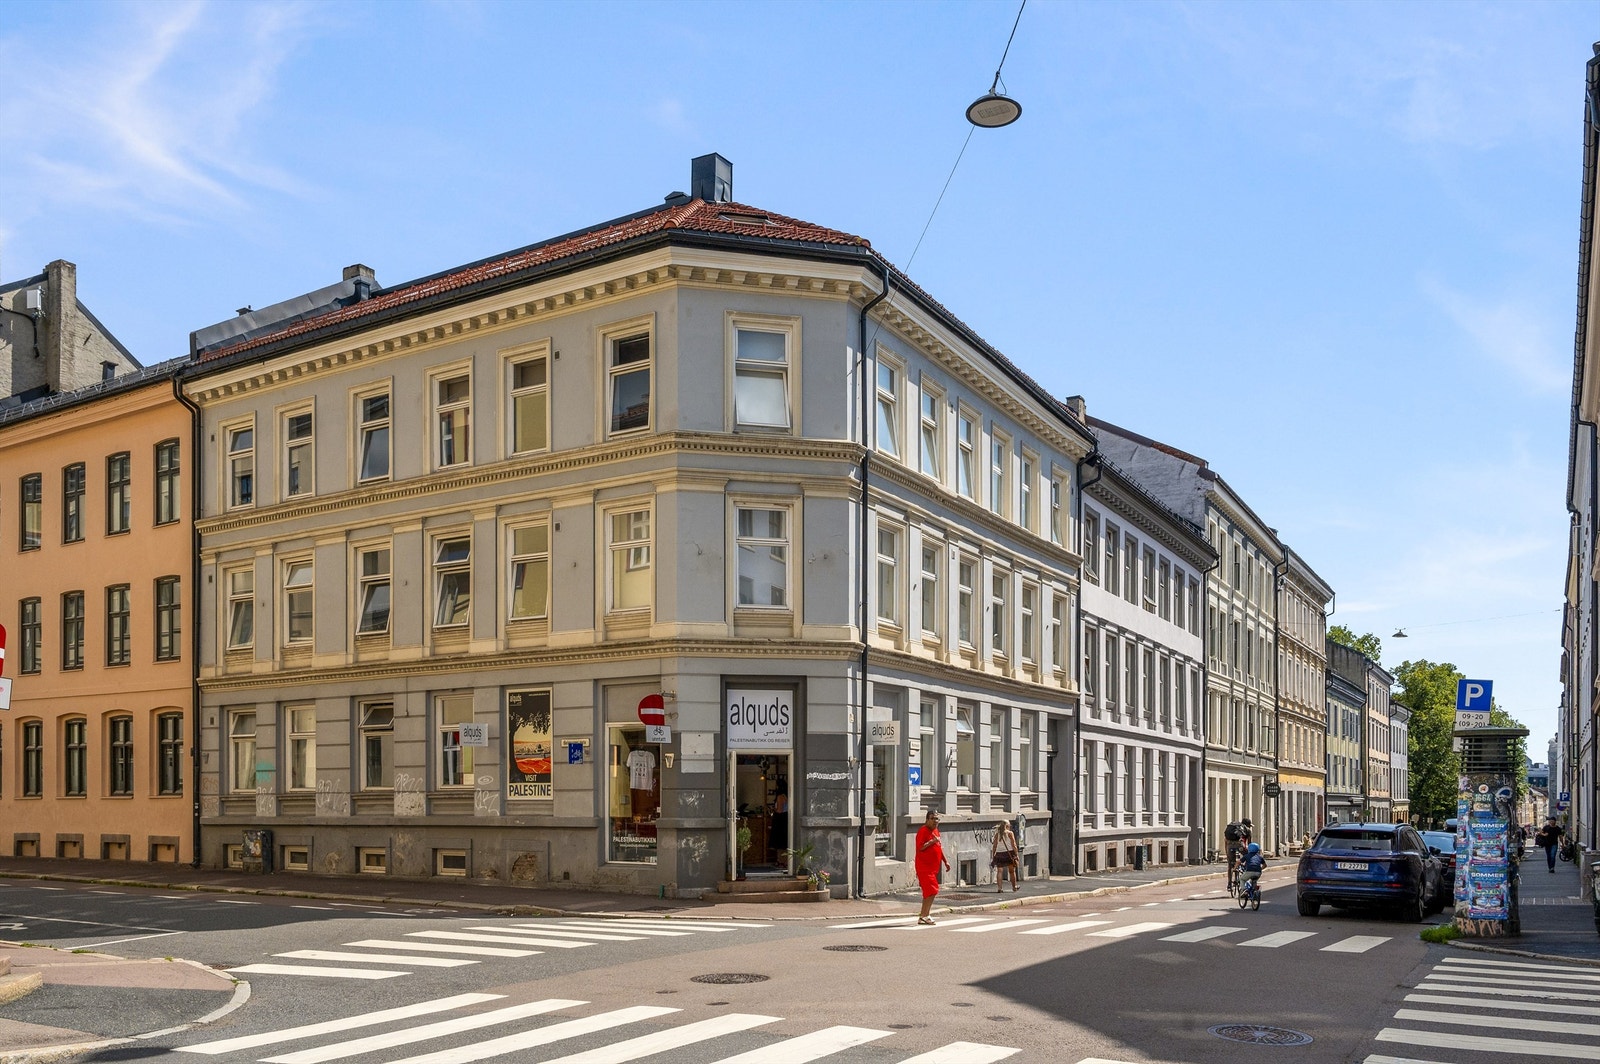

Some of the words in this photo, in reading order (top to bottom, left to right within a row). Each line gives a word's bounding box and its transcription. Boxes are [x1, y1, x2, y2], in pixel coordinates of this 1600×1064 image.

[1464, 683, 1484, 707] P
[730, 696, 790, 733] alquds
[871, 723, 895, 738] alquds
[1458, 720, 1486, 728] (09-20)
[463, 725, 482, 740] alquds
[524, 774, 538, 782] VISIT
[509, 784, 552, 797] PALESTINE
[1561, 793, 1569, 801] P
